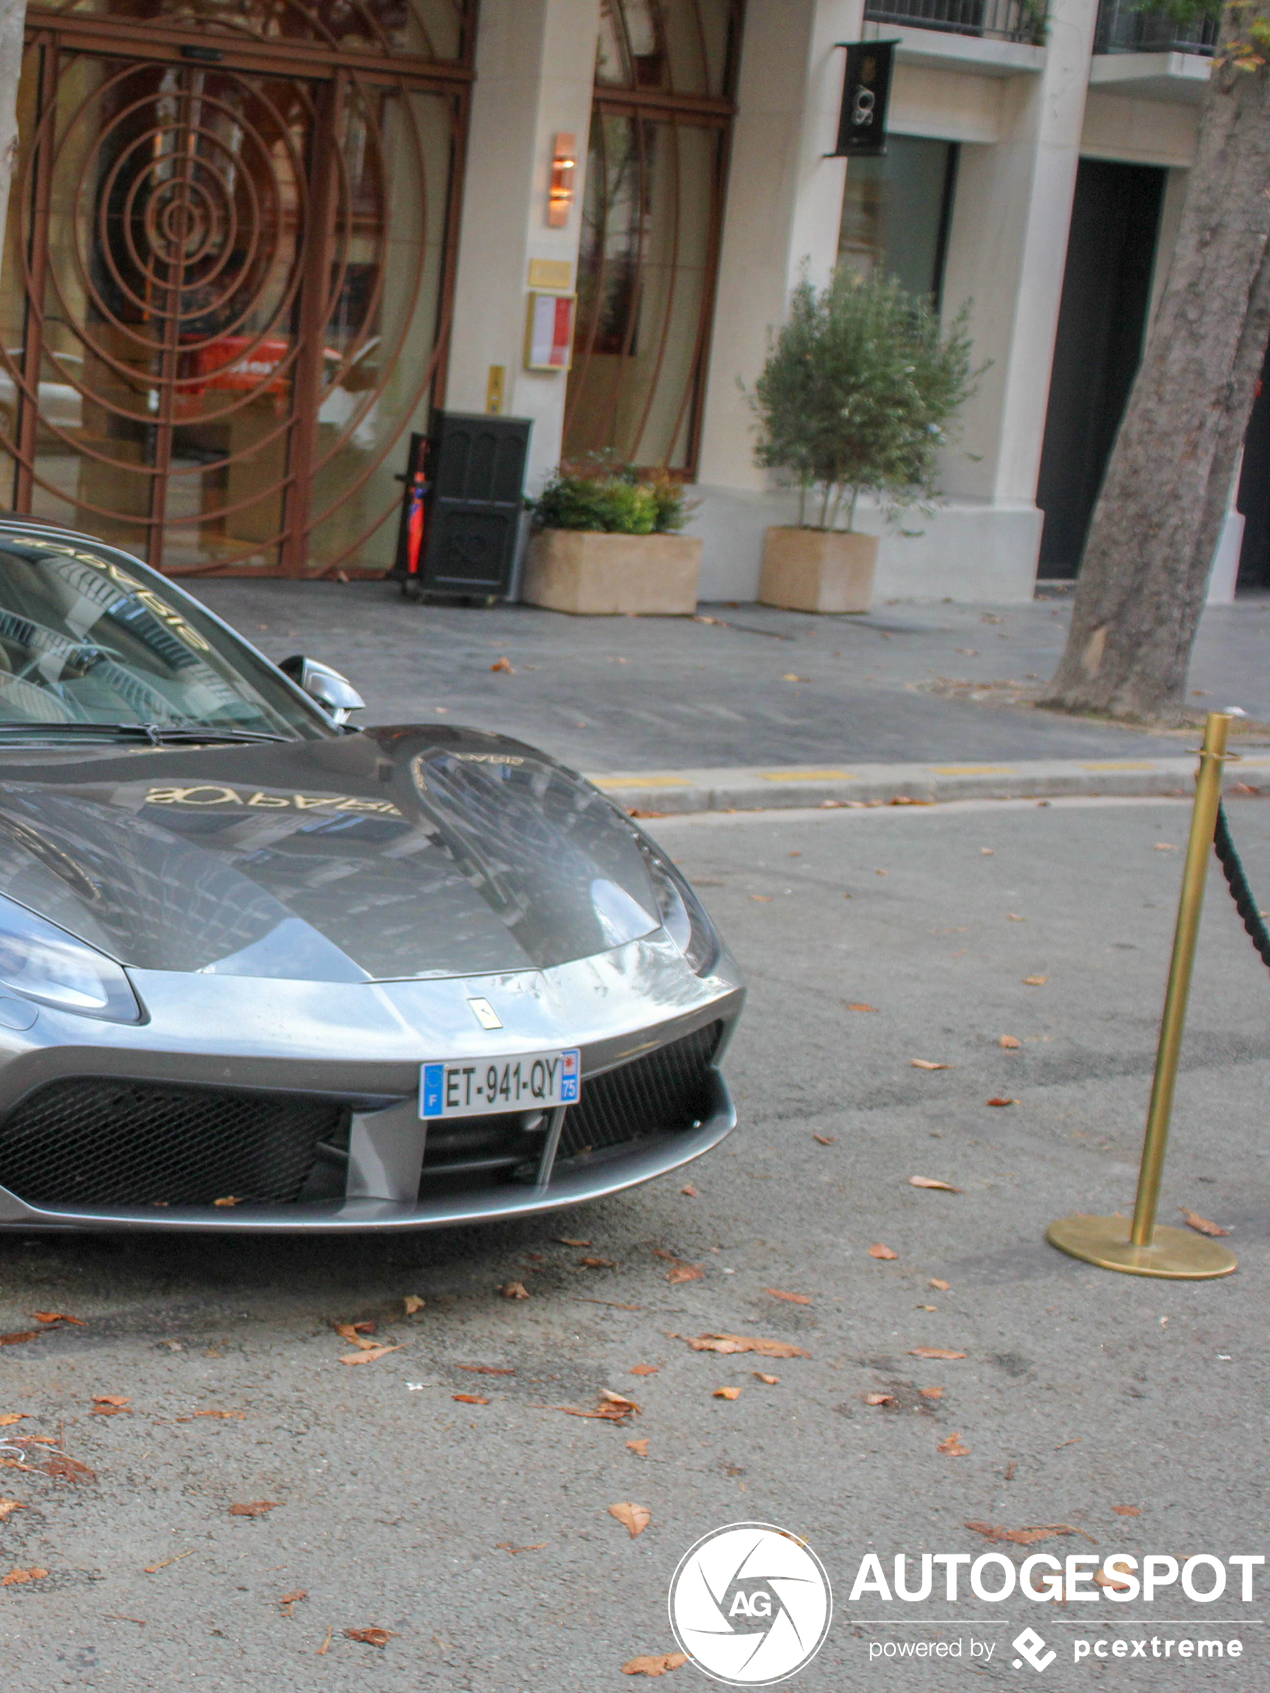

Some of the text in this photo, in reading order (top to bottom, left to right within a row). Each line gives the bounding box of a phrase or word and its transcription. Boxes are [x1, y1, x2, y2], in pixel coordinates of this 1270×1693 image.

[428, 1057, 577, 1108] F ET-941-QY 75
